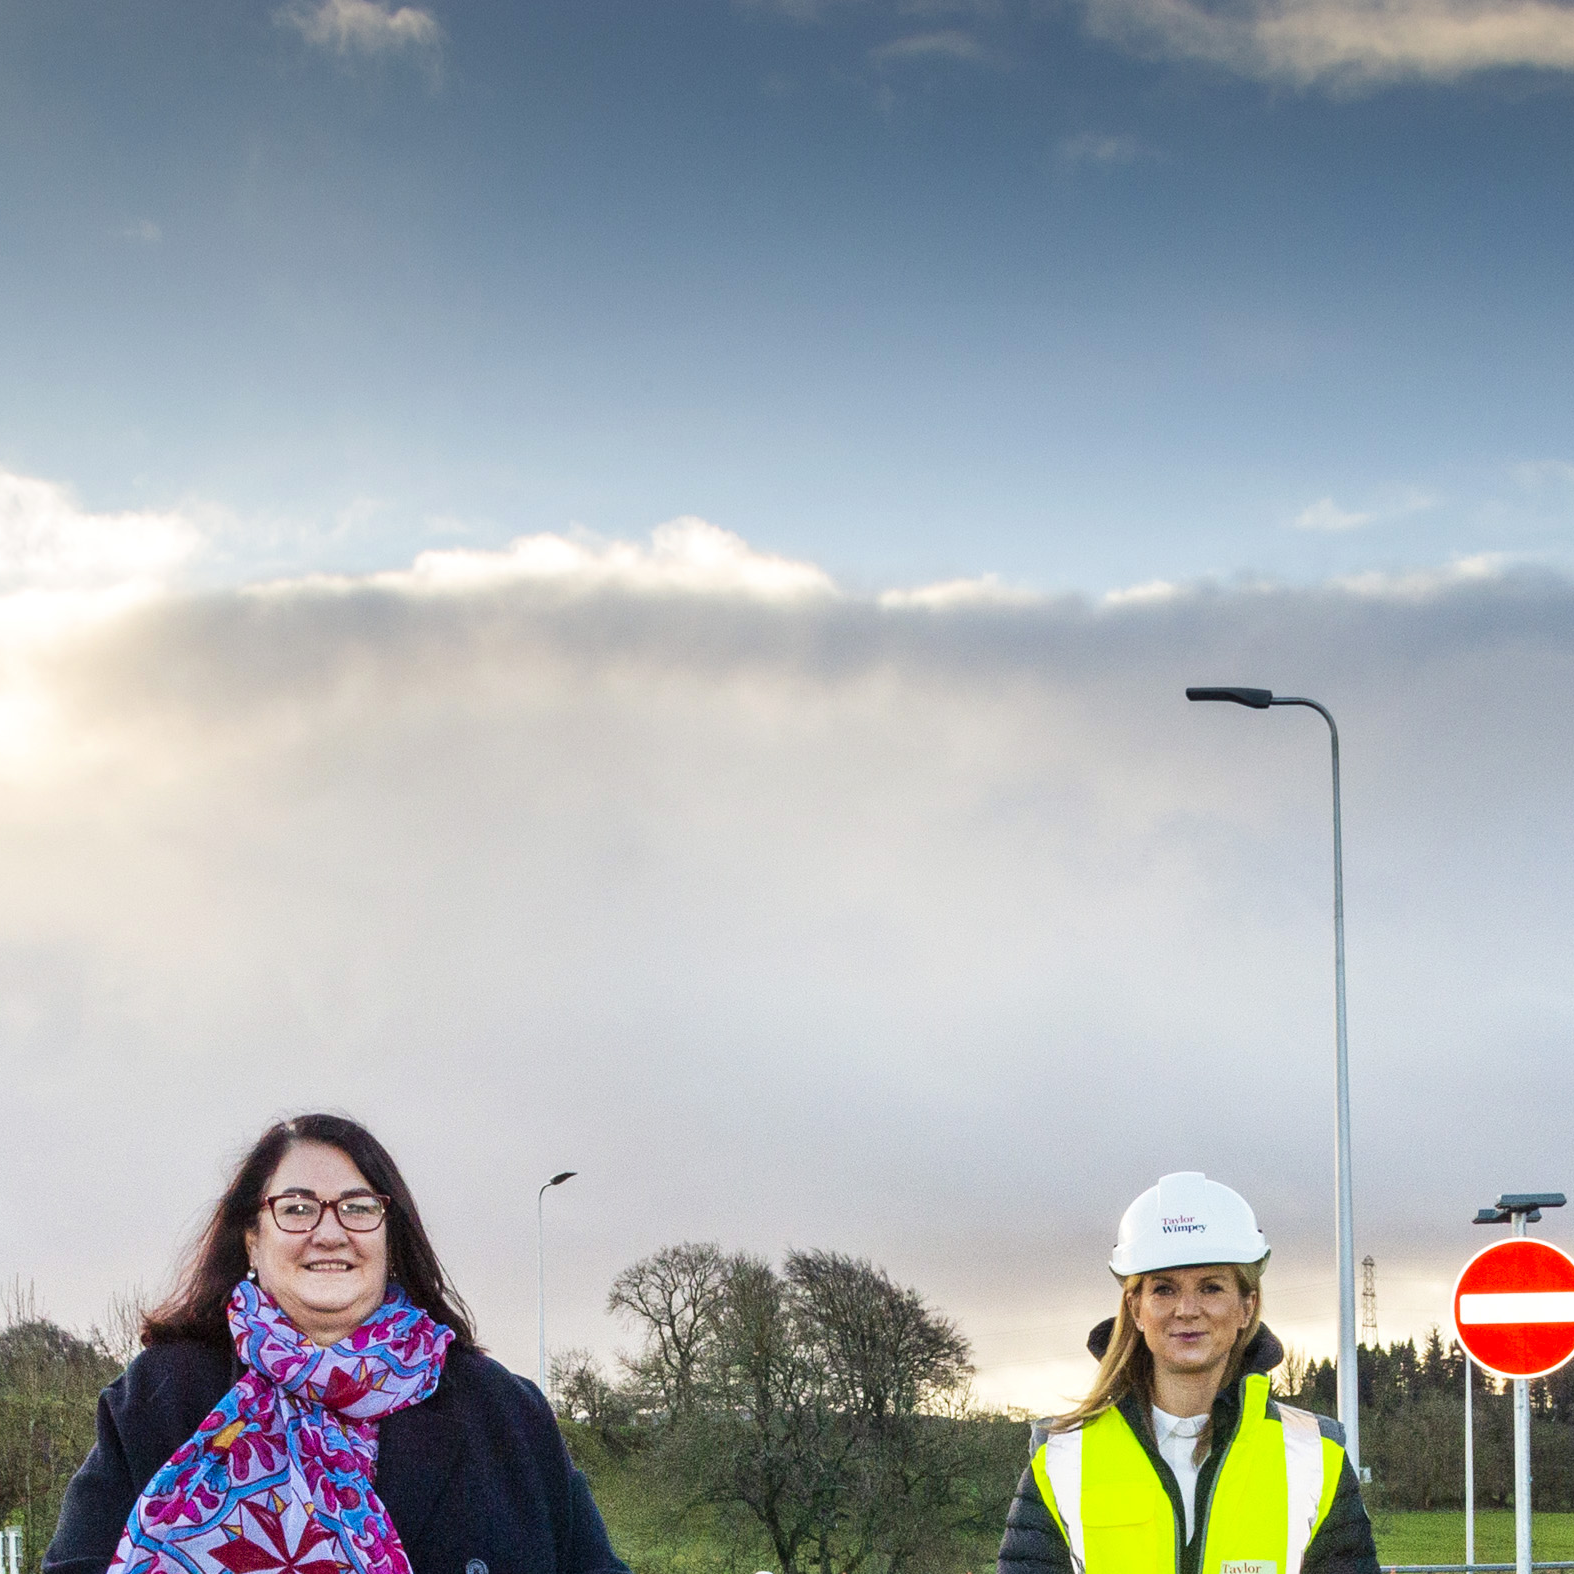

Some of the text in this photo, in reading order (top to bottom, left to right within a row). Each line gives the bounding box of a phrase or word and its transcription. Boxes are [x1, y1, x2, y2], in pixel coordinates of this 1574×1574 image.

[1161, 1215, 1195, 1225] Taylor
[1162, 1225, 1207, 1233] Wimpey
[1222, 1562, 1262, 1574] Taylor
